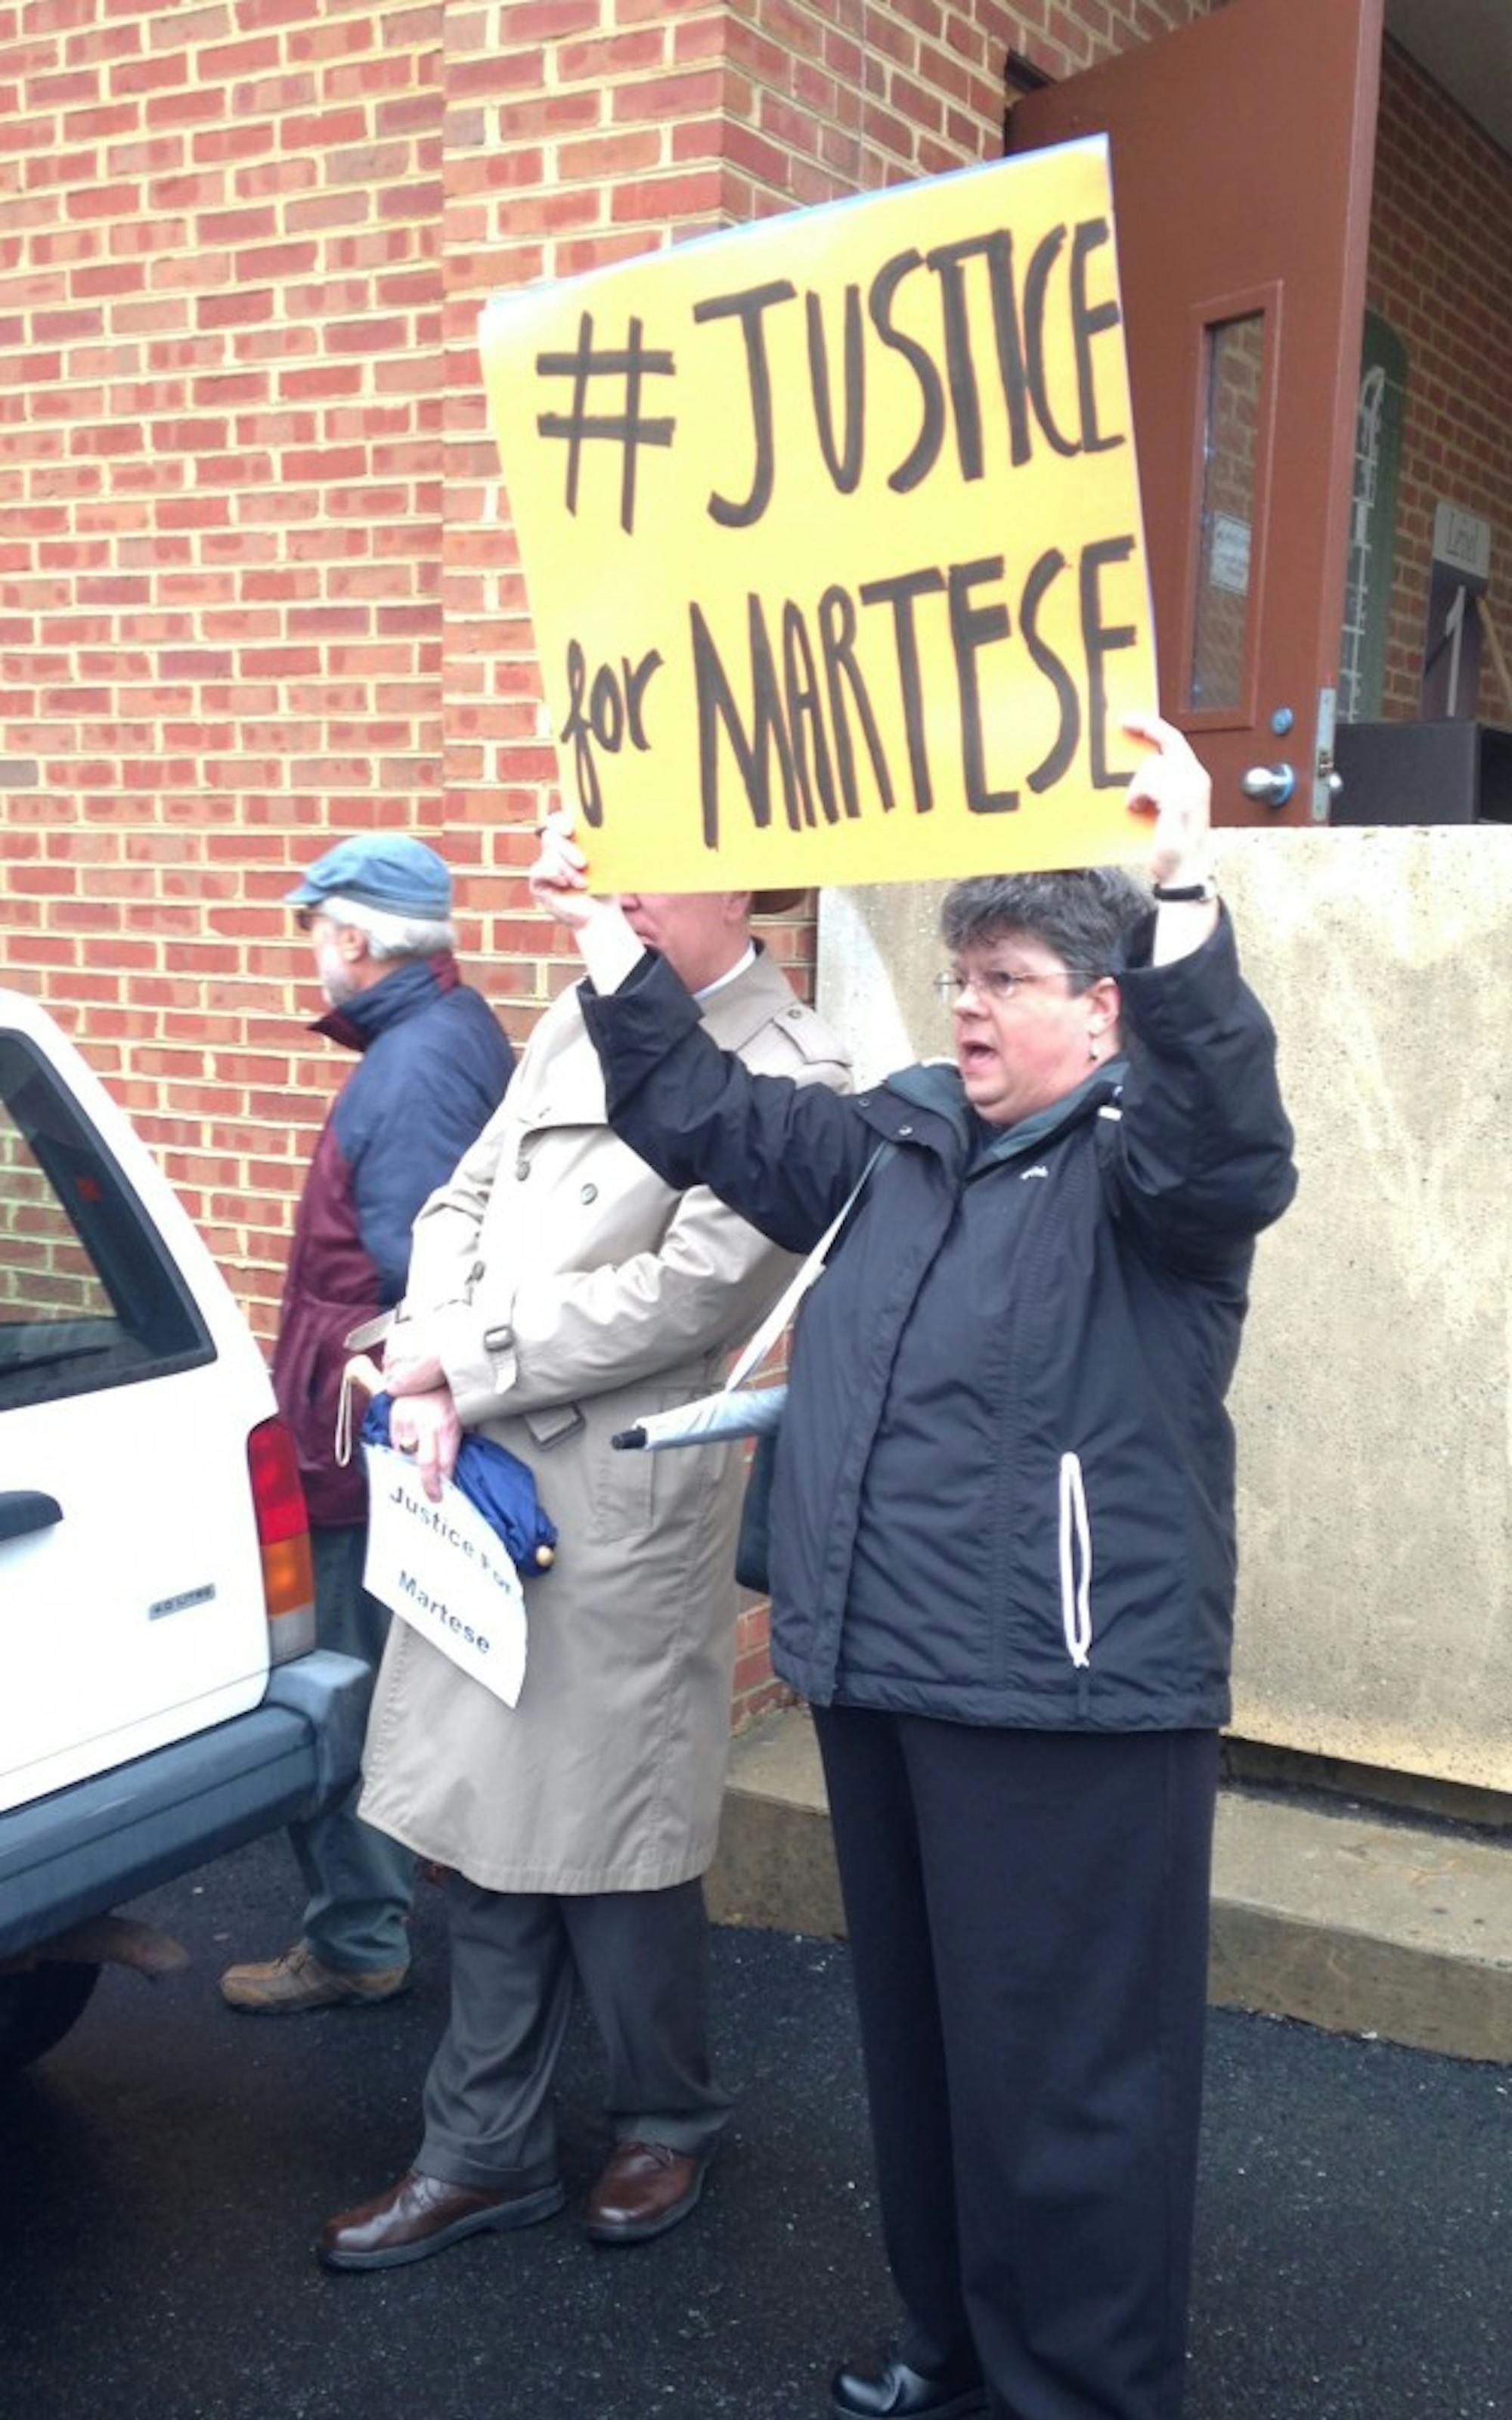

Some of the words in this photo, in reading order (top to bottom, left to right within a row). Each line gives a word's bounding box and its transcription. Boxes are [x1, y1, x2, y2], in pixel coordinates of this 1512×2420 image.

[560, 638, 665, 829] for
[689, 534, 1138, 852] MARTESE
[389, 1486, 475, 1557] Justice
[398, 1568, 490, 1655] Martese
